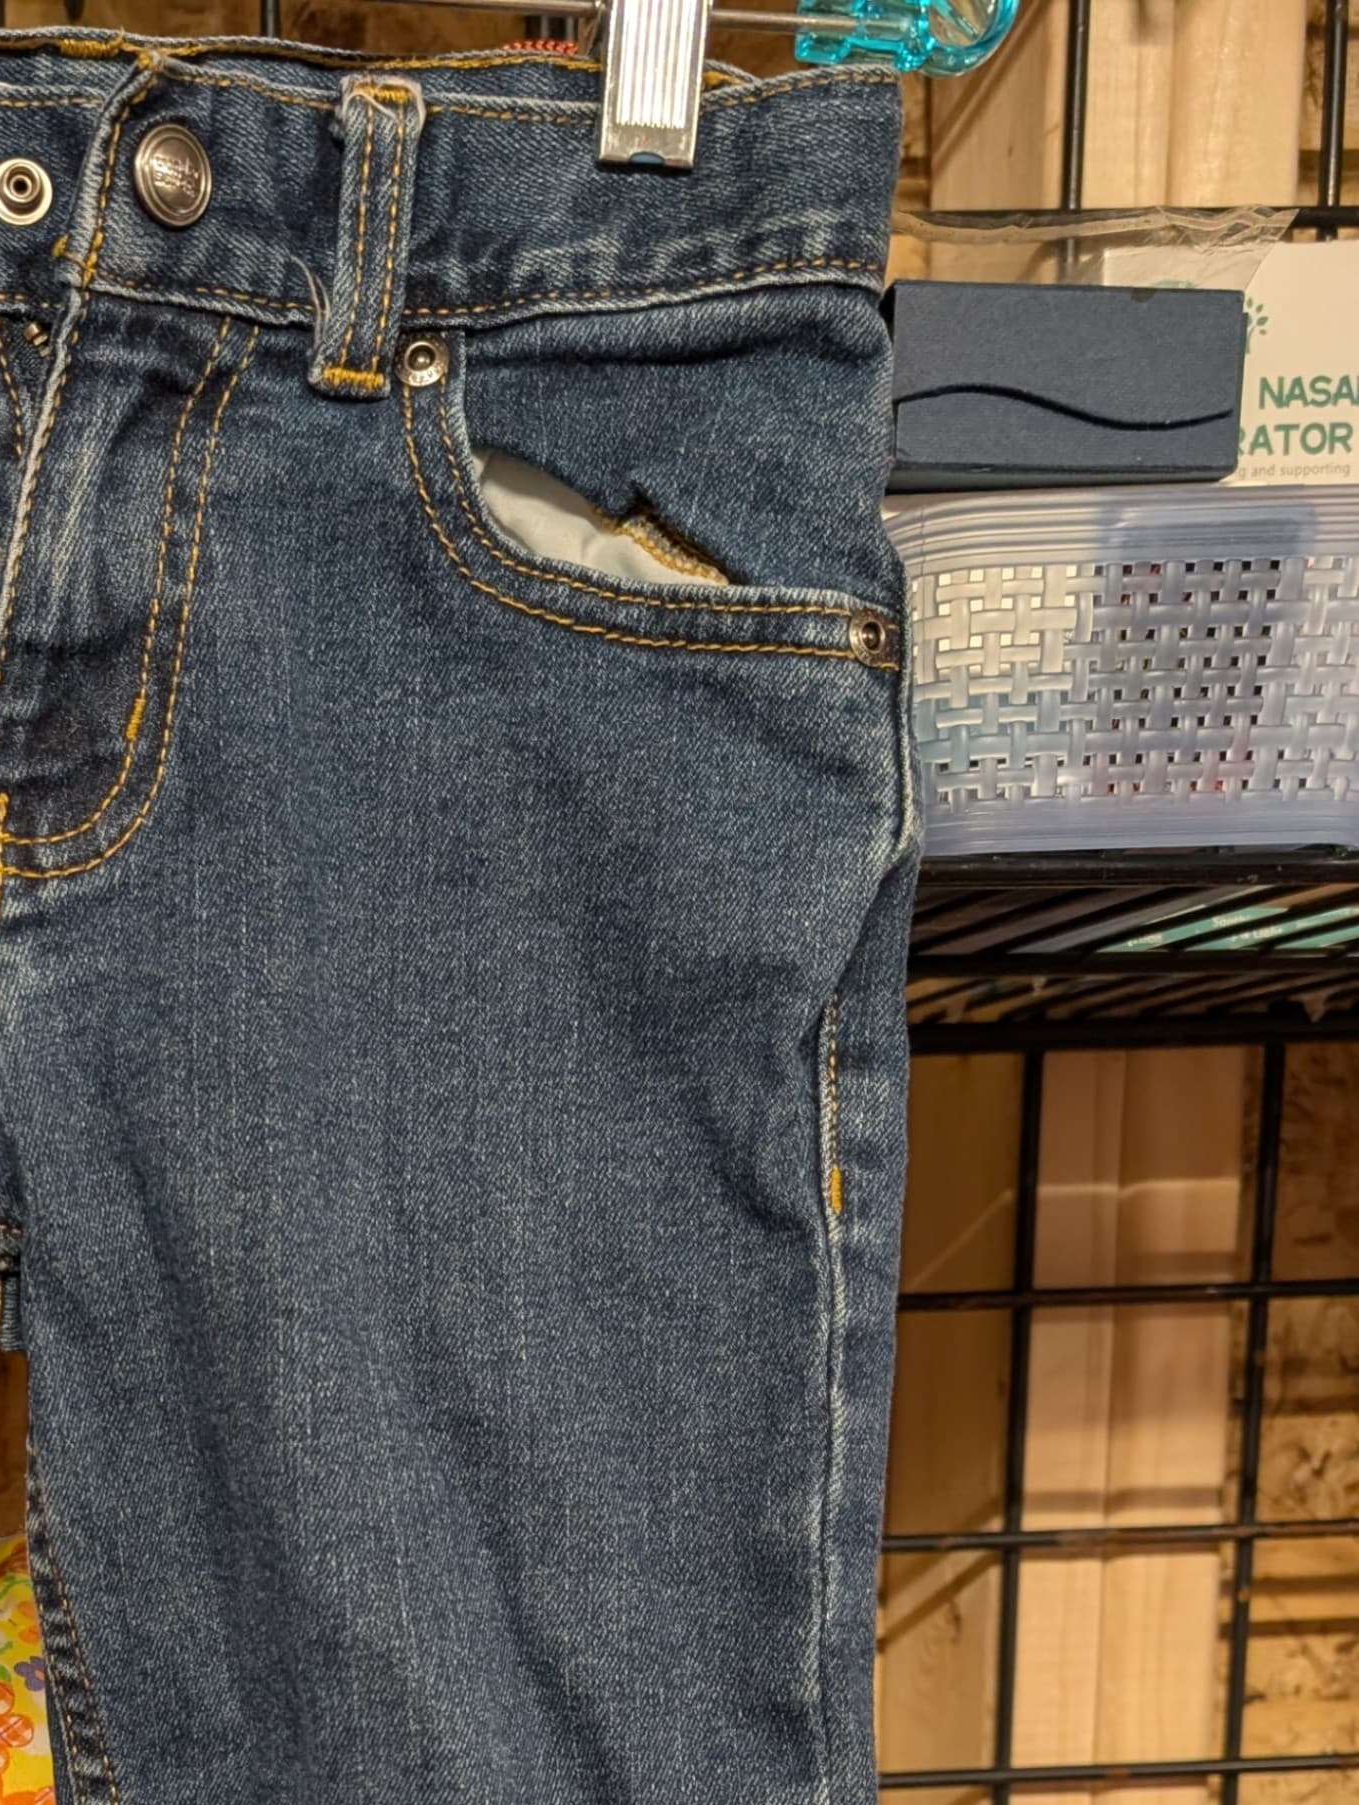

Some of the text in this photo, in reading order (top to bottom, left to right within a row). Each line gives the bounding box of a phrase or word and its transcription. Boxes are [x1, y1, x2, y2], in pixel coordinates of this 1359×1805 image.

[1258, 374, 1359, 410] NASA
[1250, 464, 1275, 477] and
[1280, 463, 1351, 477] supporting
